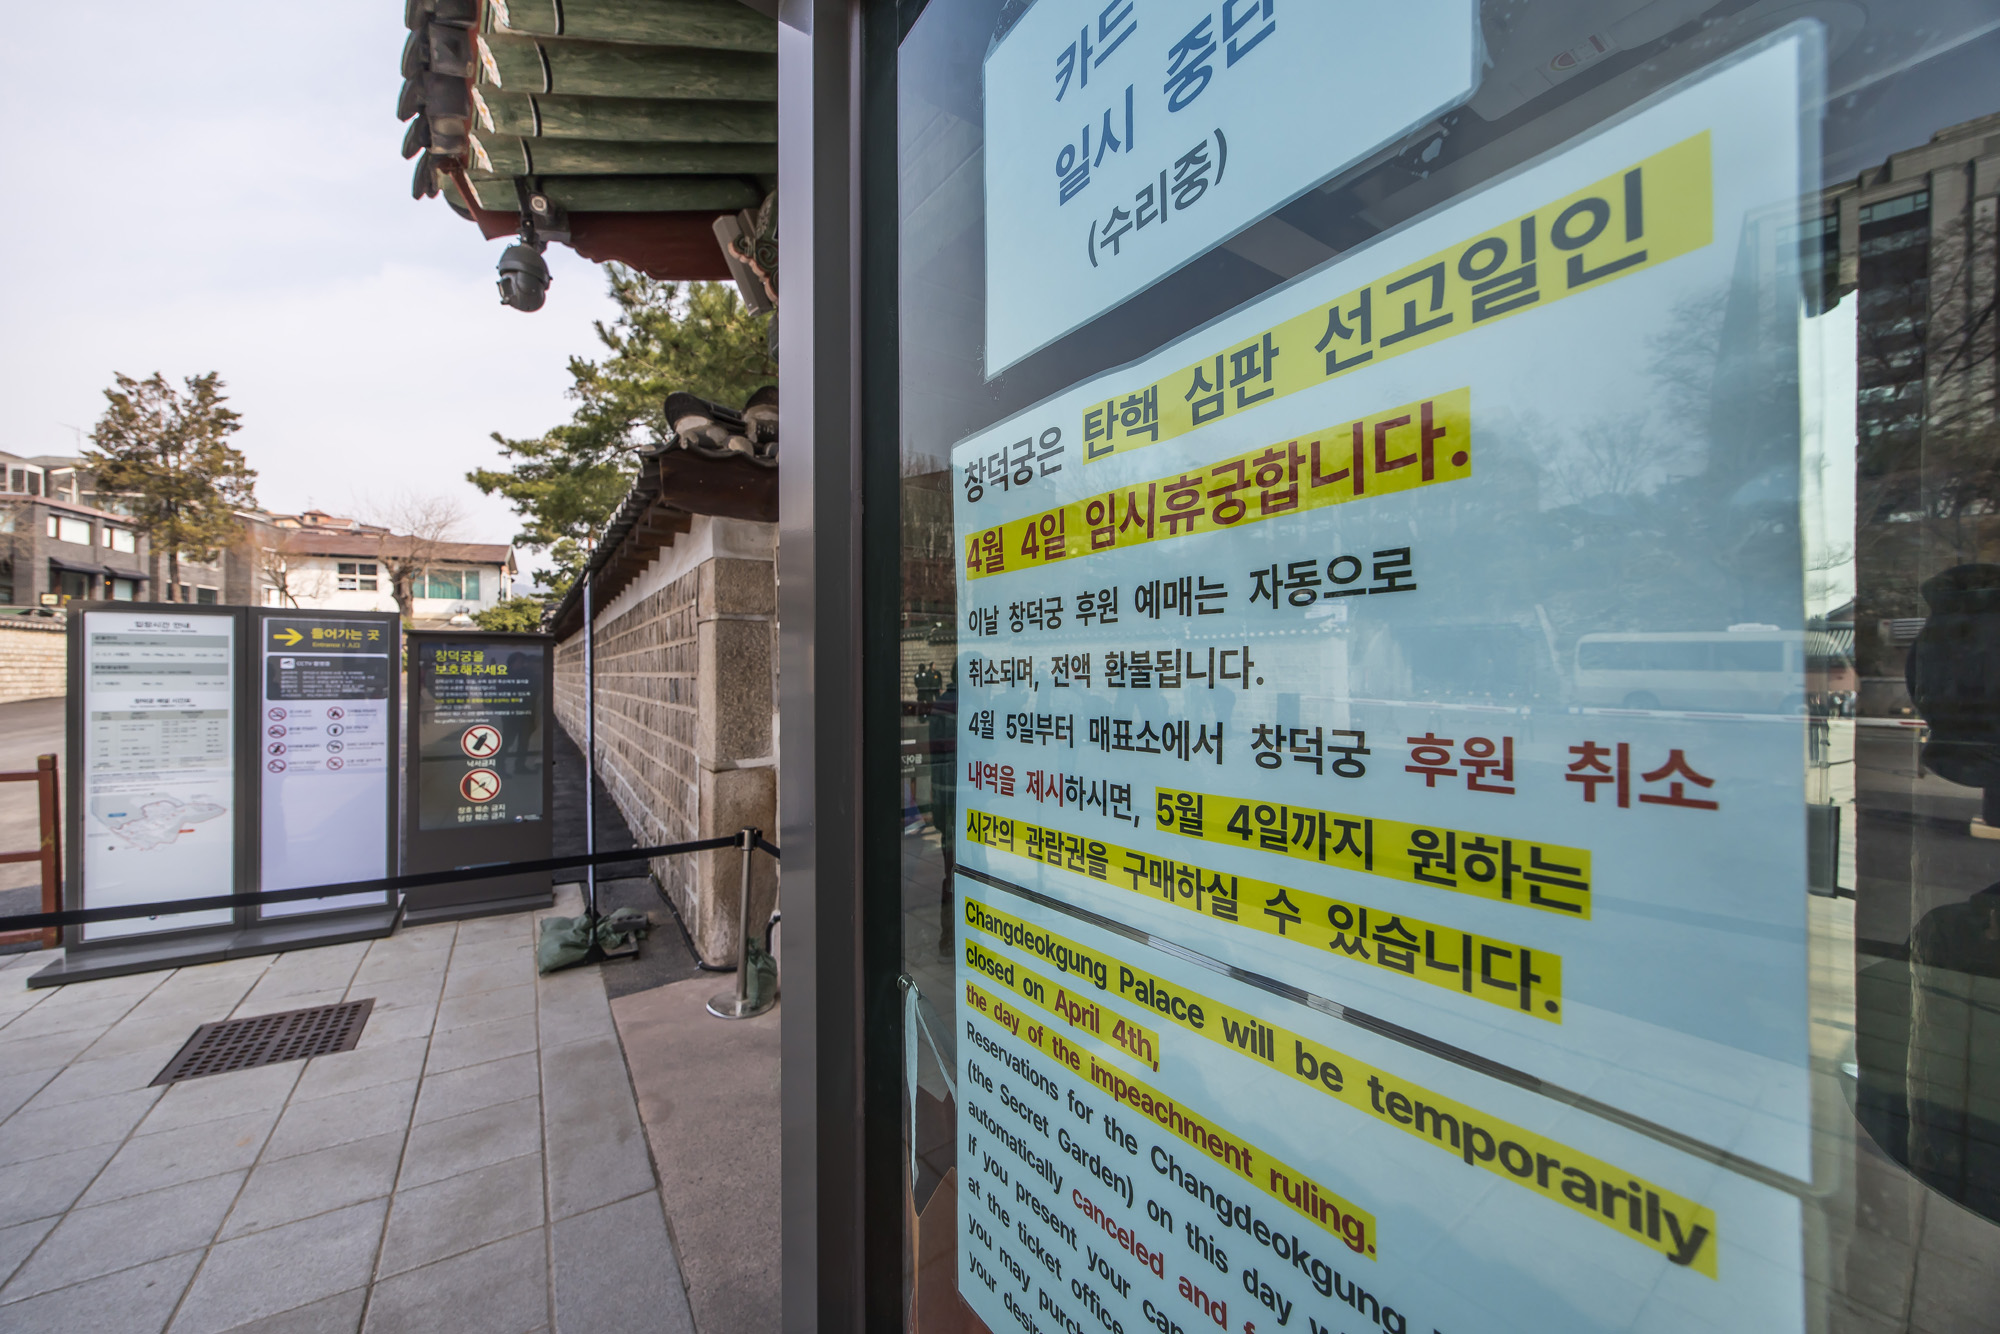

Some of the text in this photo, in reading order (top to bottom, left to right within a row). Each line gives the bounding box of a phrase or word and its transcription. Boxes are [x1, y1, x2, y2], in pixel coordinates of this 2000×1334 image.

[1055, 0, 1137, 102] 카드
[1055, 0, 1277, 206] 일시 중단
[1088, 127, 1228, 268] (수리중)
[964, 167, 1648, 503] 창덕궁은 탄핵 심판 선고일인
[966, 401, 1469, 575] 4월 4일 임시휴궁합니다.
[311, 628, 380, 641] 들어가는 곳
[435, 650, 485, 663] 창덕궁을
[968, 546, 1418, 637] 이날 창덕궁 후원 예매는 자동으로
[968, 645, 1265, 692] 취소되며, 전액 환불됩니다.
[434, 664, 508, 676] 보호해주세요
[968, 710, 1720, 811] 4월 5일부터 매표소에서 창덕궁 후원 취소
[968, 760, 1589, 915] 내역을 제시하시면, 5월 4일까지 원하는
[967, 811, 1560, 1015] 시간의 관람권을 구매하실 수 있습니다.
[965, 901, 1710, 1266] Changdeokgung Palace will be temporarily
[966, 945, 1159, 1072] closed on April 4th,
[966, 984, 1377, 1255] the day of the impeachment ruling.
[966, 1020, 1407, 1334] Reservations for the Changdeokgung
[968, 1058, 1293, 1327] (the Secret Garden) on this day
[968, 1101, 1227, 1331] automatically canceled and
[968, 1133, 977, 1156] If
[983, 1151, 1008, 1187] you
[1016, 1180, 1078, 1252] present
[1087, 1244, 1131, 1300] your
[968, 1213, 992, 1251] you
[1000, 1246, 1030, 1293] may
[968, 1176, 1124, 1334] at the ticket office
[969, 1251, 1043, 1334] your desir
